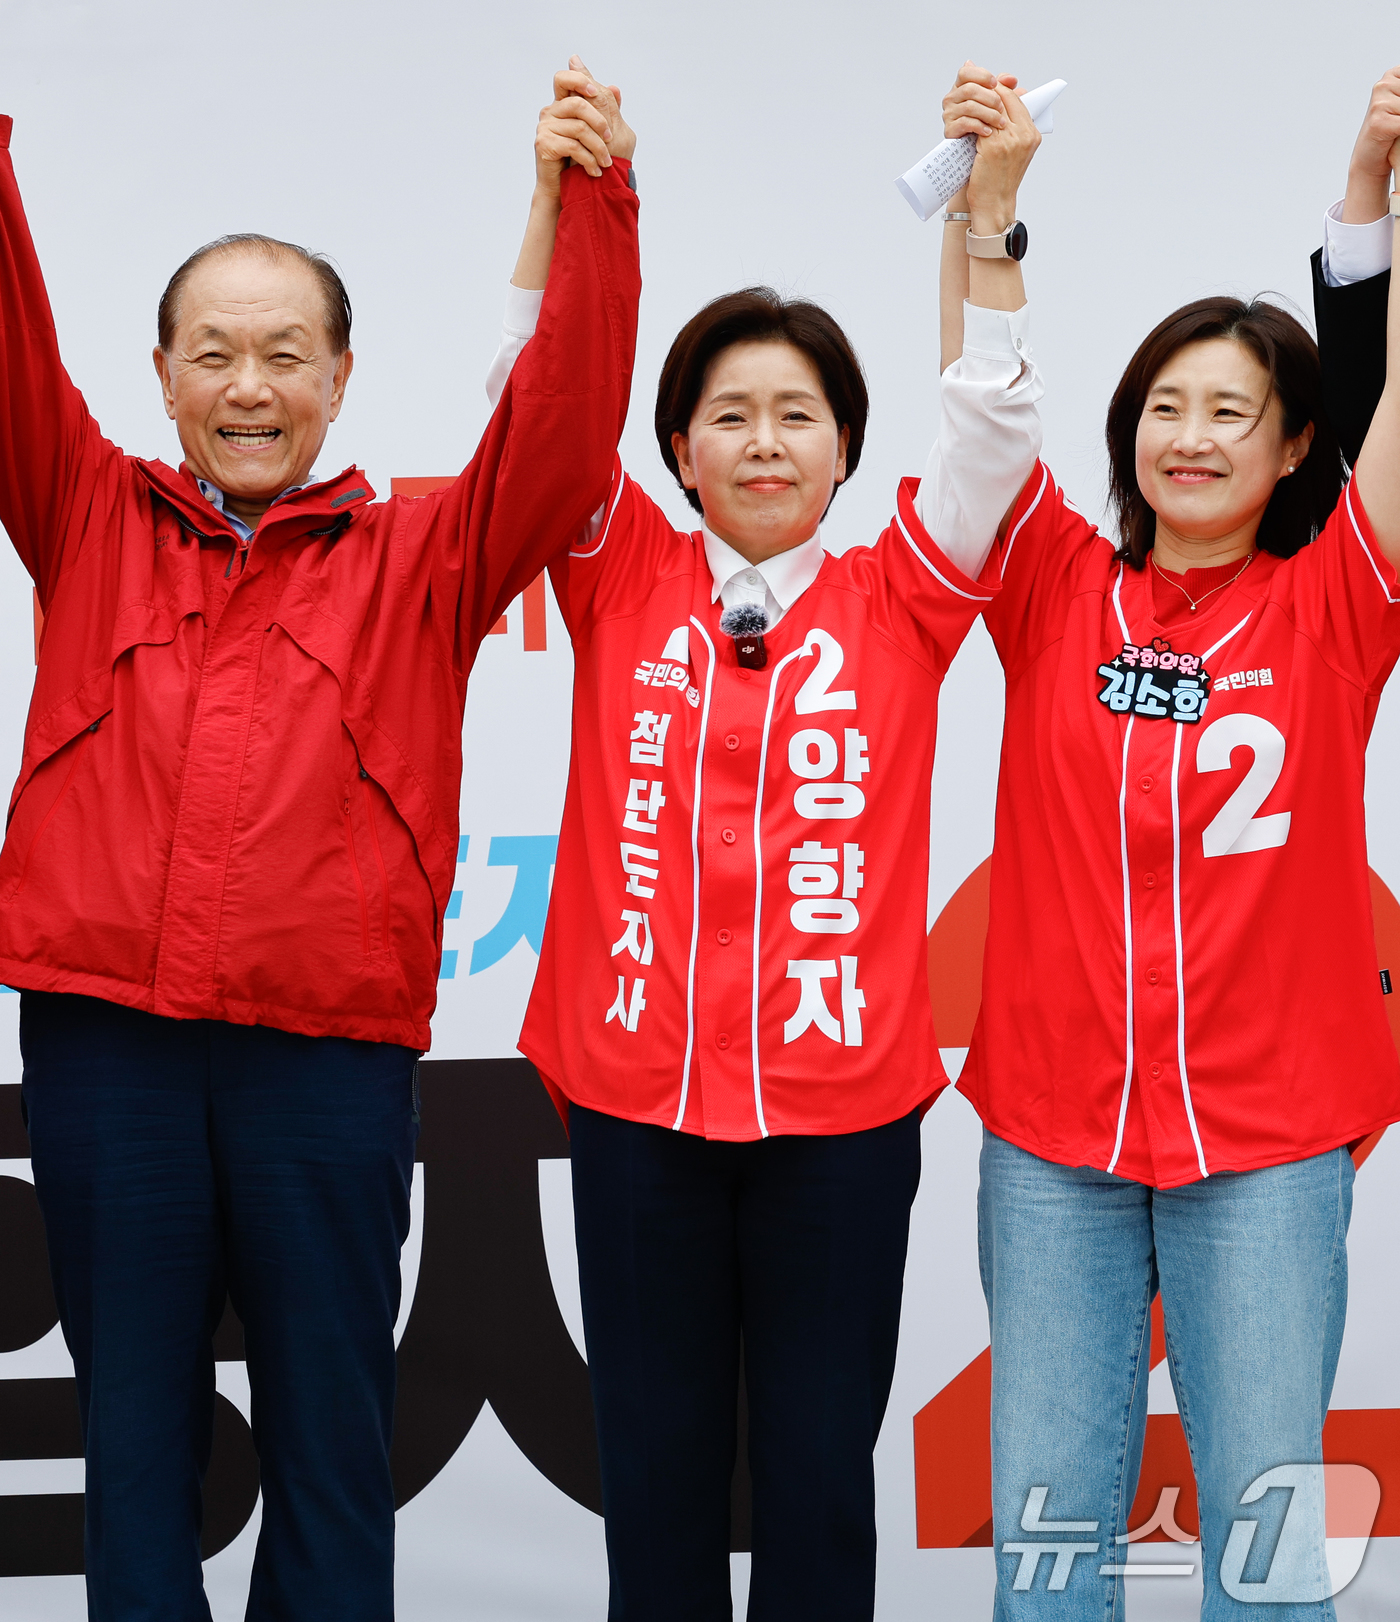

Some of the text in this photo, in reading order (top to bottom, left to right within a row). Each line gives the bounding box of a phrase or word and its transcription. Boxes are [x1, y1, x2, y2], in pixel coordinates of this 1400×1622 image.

[795, 628, 857, 715] 2
[1097, 666, 1209, 722] 김소희
[1122, 645, 1200, 676] 국회의원
[1213, 668, 1274, 691] 국민의힘
[1196, 713, 1291, 858] 2
[784, 728, 870, 1047] 양향자
